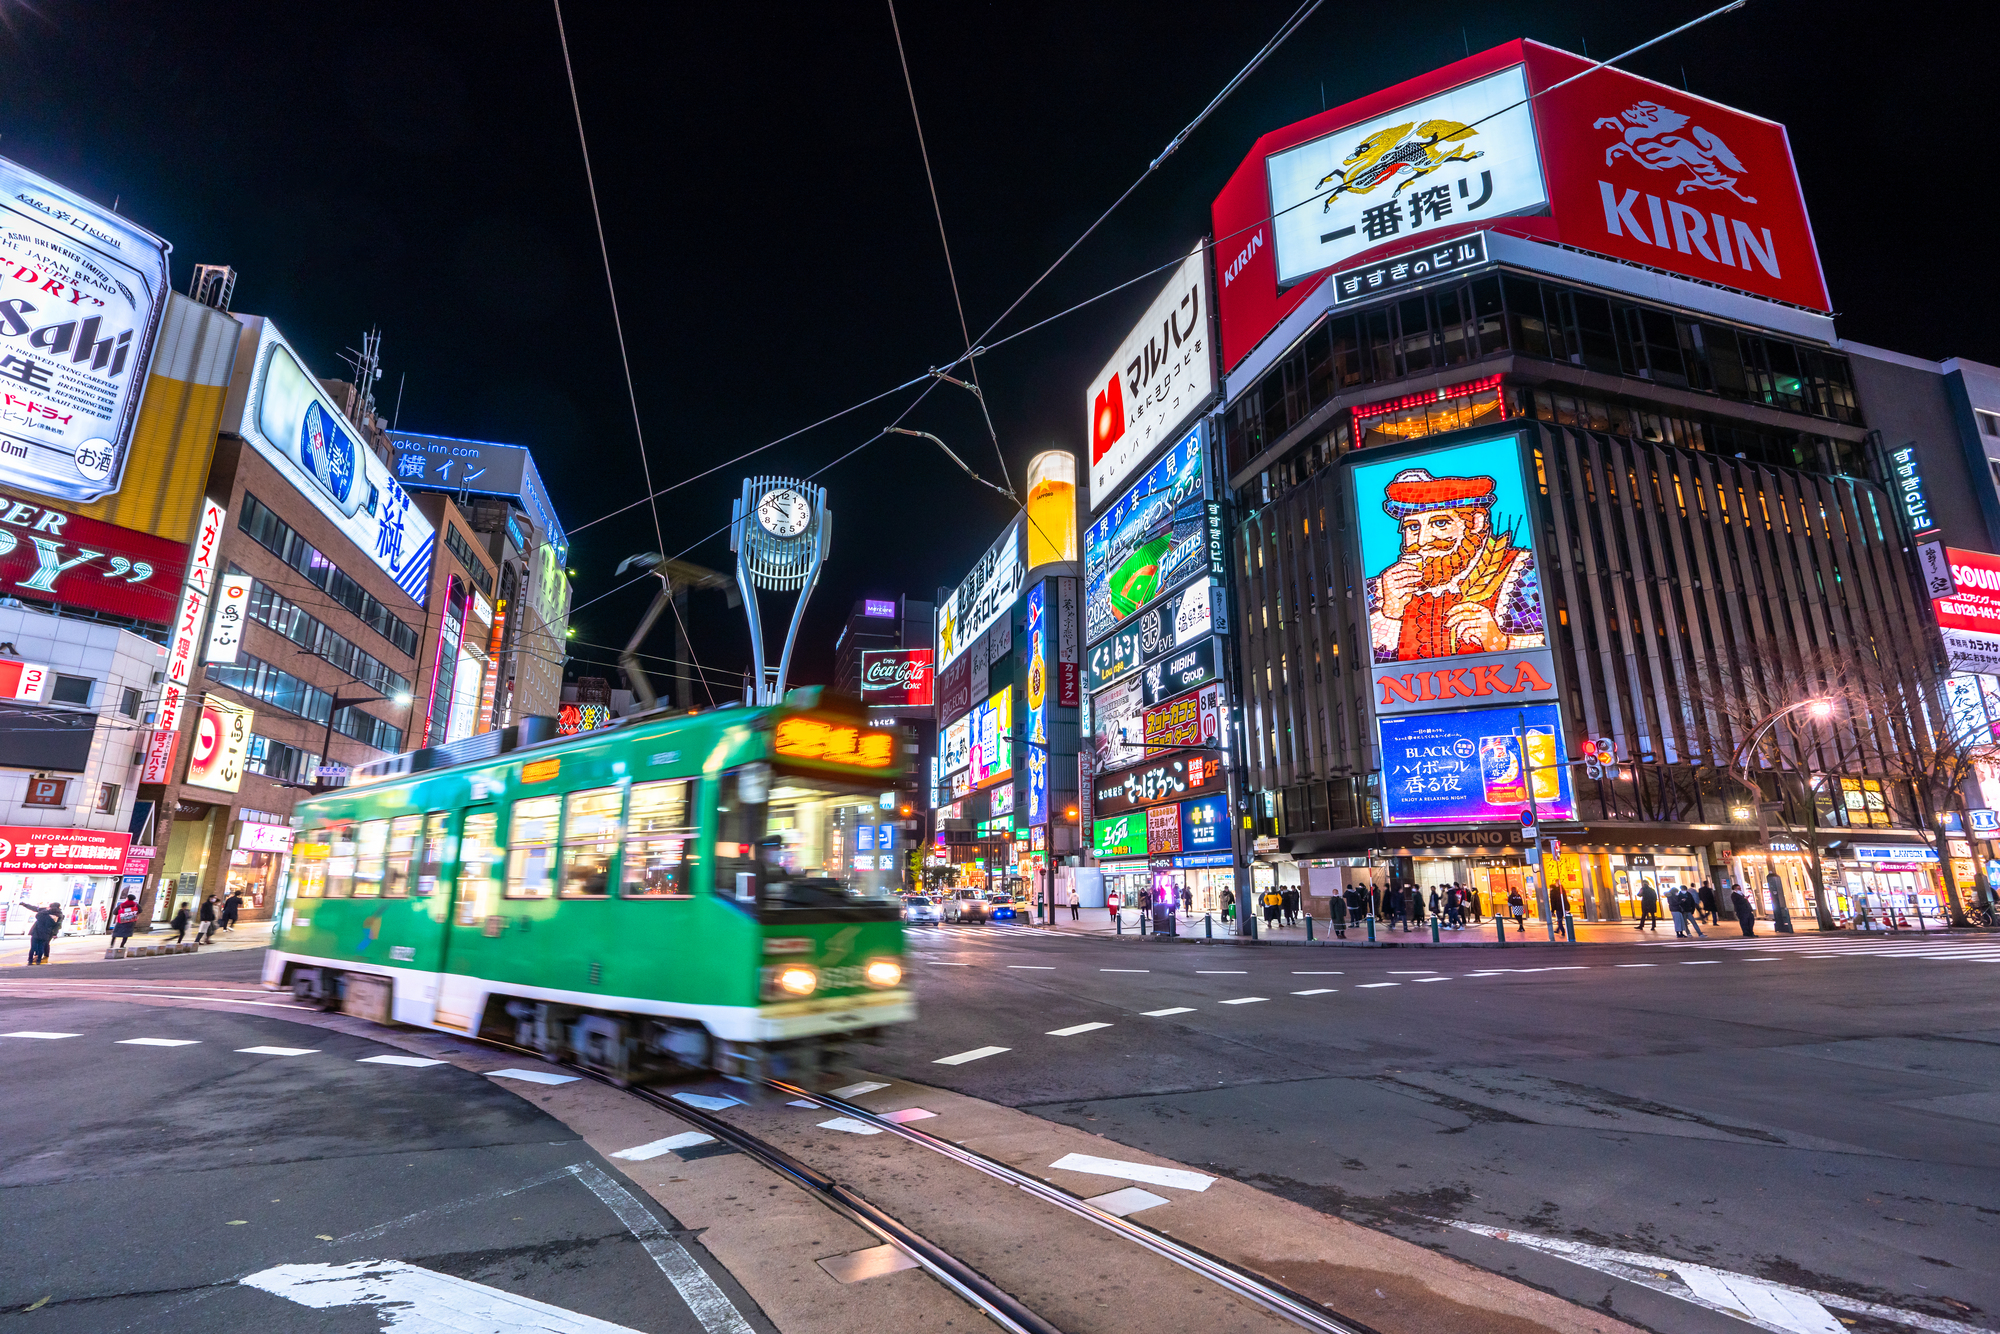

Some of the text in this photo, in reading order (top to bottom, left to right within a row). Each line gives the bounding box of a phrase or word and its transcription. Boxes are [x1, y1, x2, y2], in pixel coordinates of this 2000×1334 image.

[1320, 170, 1494, 245] 一番搾り
[1597, 180, 1782, 280] KIRIN
[8, 232, 109, 283] ASAHI BREWERIES LIMITED
[1224, 229, 1263, 288] KIRIN
[1344, 243, 1476, 294] すすきのビル
[24, 249, 70, 273] JAPAN
[74, 270, 117, 295] BRAND
[34, 262, 79, 287] SUPER
[1127, 282, 1199, 400] マルハン
[0, 354, 54, 393] 生
[15, 348, 55, 366] BREWED
[56, 363, 81, 377] USING
[82, 373, 120, 391] CAREFULLY
[30, 388, 44, 397] OF
[44, 395, 71, 407] ASAHI
[72, 404, 96, 416] SUPER
[57, 381, 96, 399] BREWING
[1098, 383, 1196, 488] 新しいパチンコへ
[77, 447, 113, 473] お酒
[781, 493, 790, 501] 12
[1037, 492, 1054, 500] SAPPORO
[1085, 435, 1200, 552] 世界がまだ見ぬ
[375, 496, 405, 573] 純
[1156, 530, 1203, 593] FIGHTERS
[957, 549, 997, 614] 北海道は
[159, 506, 222, 731] ベガスベガス狸小路店
[867, 605, 893, 613] Mercure
[1088, 594, 1112, 628] 2023
[1158, 634, 1174, 653] EVE
[867, 660, 925, 682] Coca-Cola
[944, 656, 967, 690] カラオケ
[1170, 652, 1196, 675] HIBIKI
[1182, 667, 1204, 684] Group
[24, 669, 43, 695] 3F
[903, 680, 922, 690] Coke
[1065, 664, 1075, 699] カラオケ
[1377, 660, 1553, 705] NIKKA
[952, 687, 968, 710] ECHO
[1146, 699, 1197, 735] ネットカフェ
[1174, 723, 1198, 745] ダーツ
[146, 732, 168, 781] ほっとハウス
[1405, 745, 1452, 758] BLACK
[1204, 759, 1219, 778] 2F
[1392, 760, 1470, 776] ハイボール
[1404, 774, 1463, 794] 香る夜
[31, 834, 87, 842] INFORMATION
[1102, 817, 1129, 847] エイブル
[1412, 831, 1503, 846] SUSUKINO
[15, 843, 122, 860] すすきの無料案内所
[1893, 849, 1923, 858] LAWSON
[38, 862, 57, 870] right
